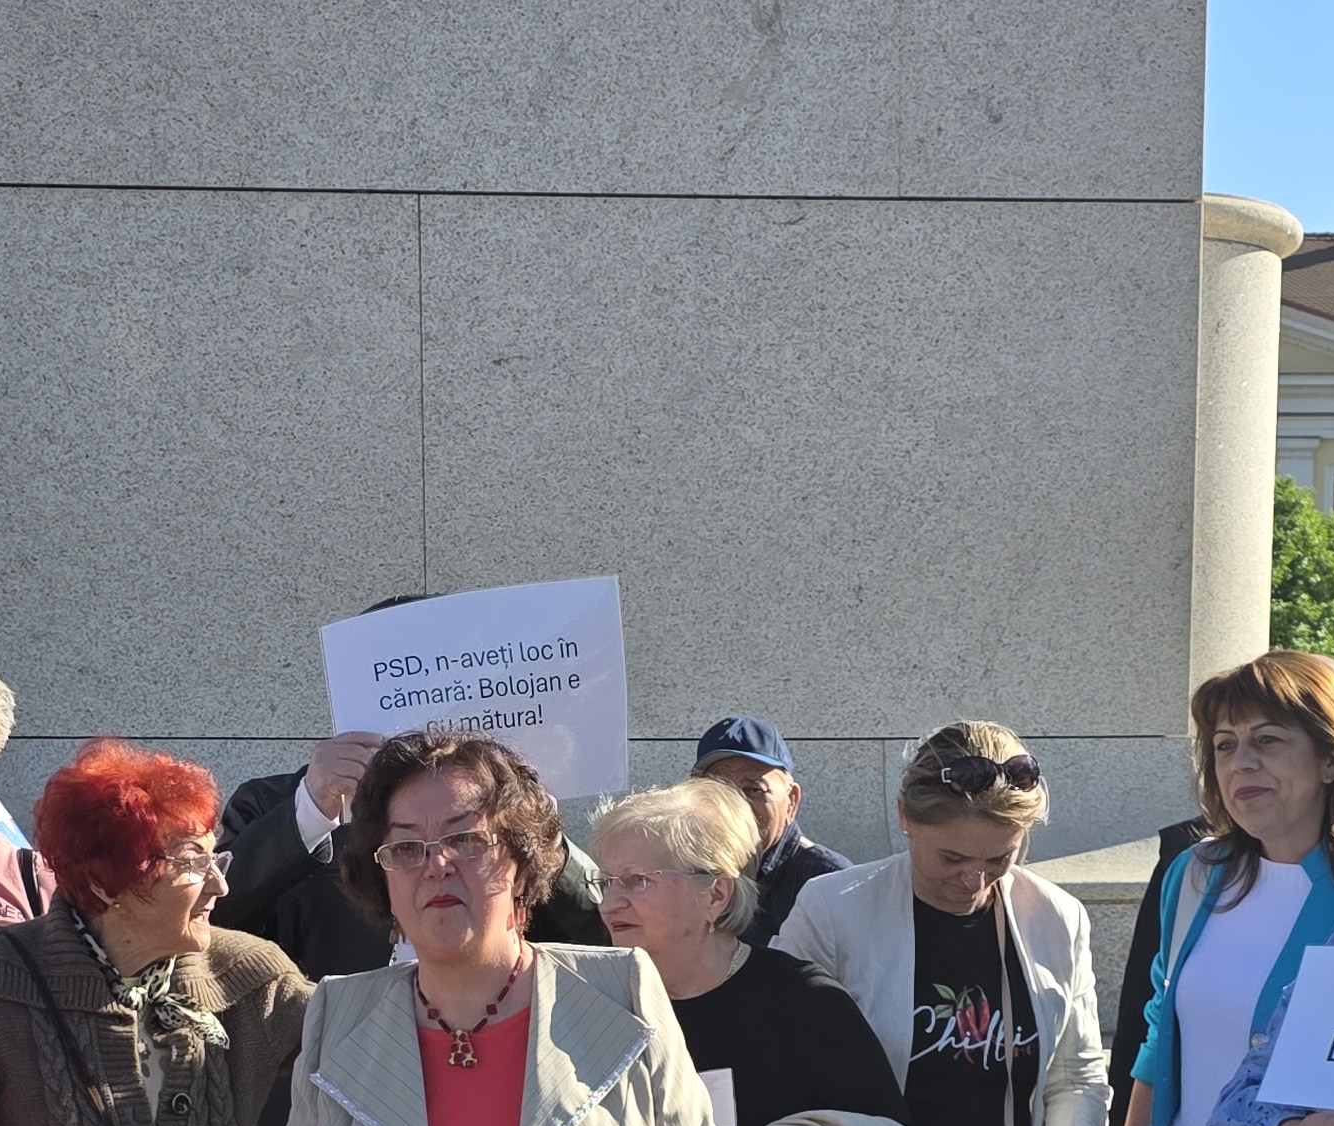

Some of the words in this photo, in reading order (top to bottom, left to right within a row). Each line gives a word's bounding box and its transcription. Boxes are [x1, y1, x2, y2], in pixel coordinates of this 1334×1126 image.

[373, 655, 429, 681] PSD,
[435, 643, 513, 671] n-aveți
[519, 642, 553, 662] loc
[557, 637, 578, 658] în
[379, 680, 473, 710] cămară:
[479, 673, 562, 699] Bolojan
[568, 673, 580, 689] e
[460, 704, 543, 732] mătura!
